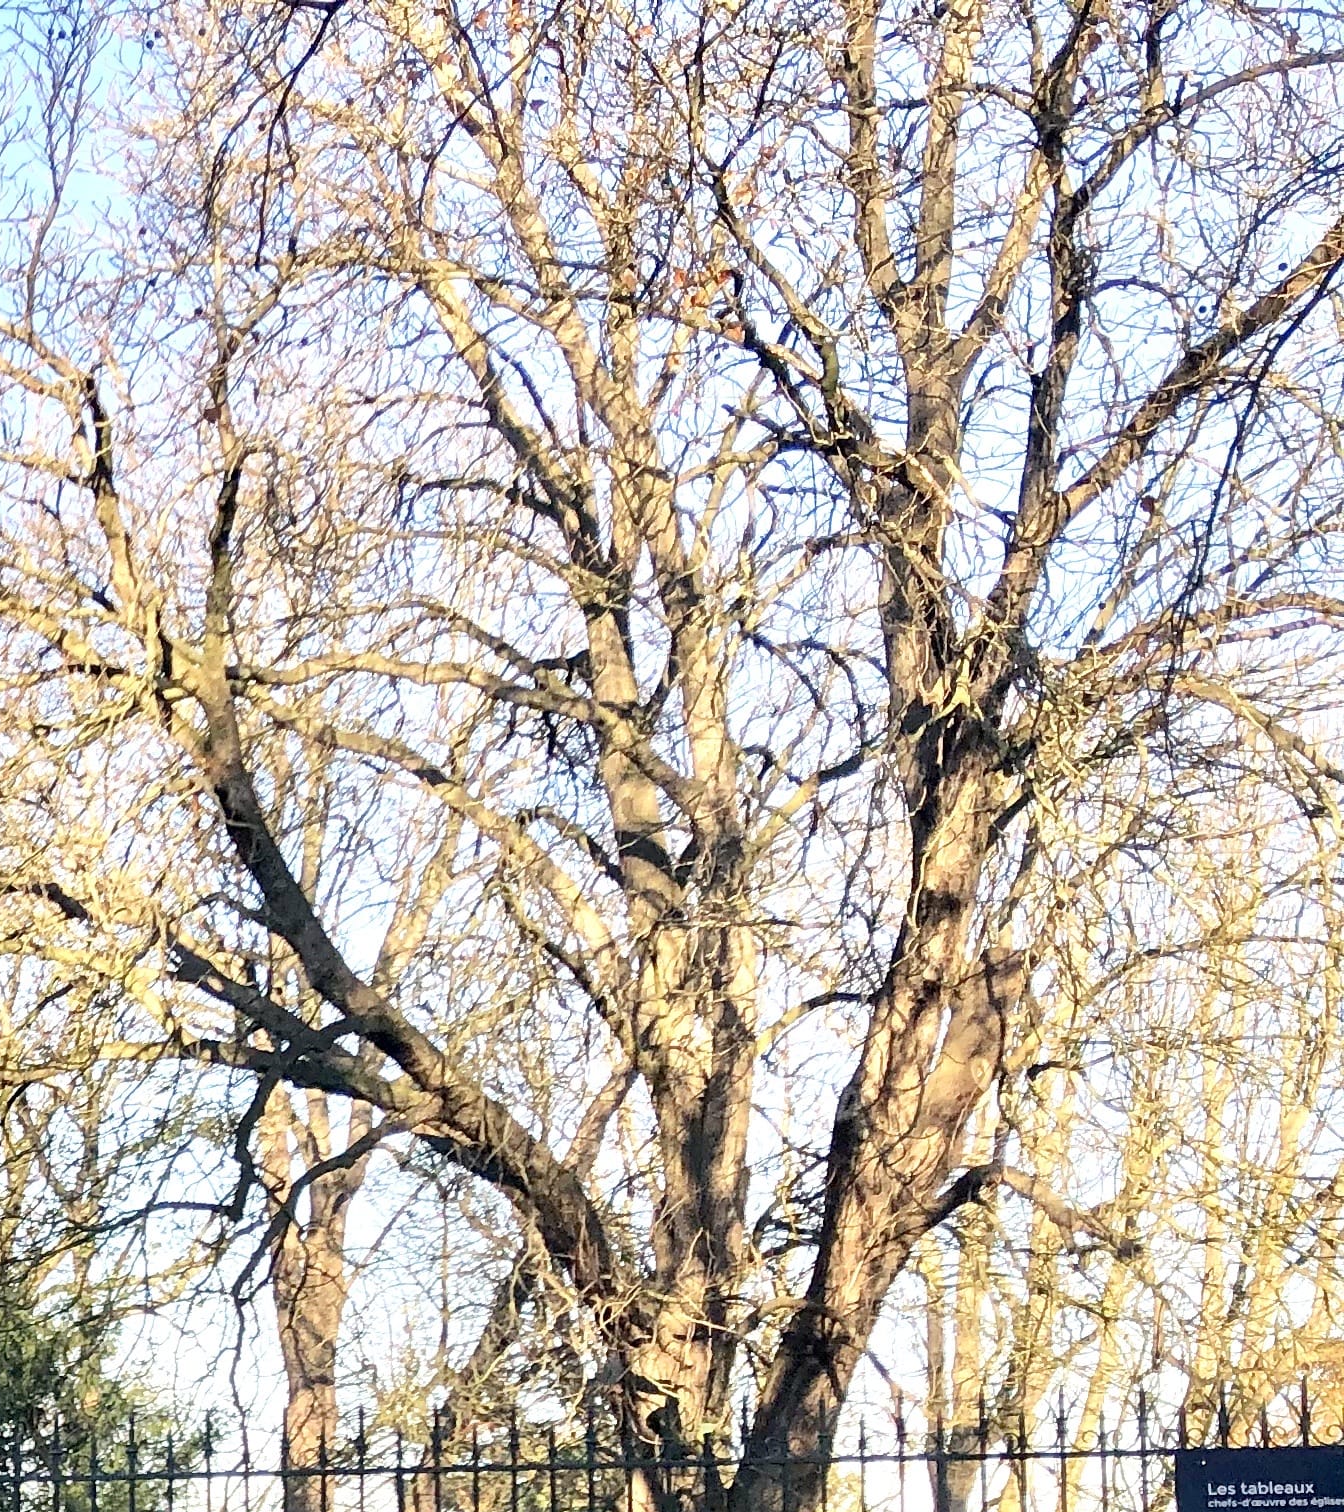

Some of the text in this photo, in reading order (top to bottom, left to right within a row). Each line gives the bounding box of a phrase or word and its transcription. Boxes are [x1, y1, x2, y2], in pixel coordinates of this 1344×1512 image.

[1207, 1481, 1315, 1496] Les tableaux
[1288, 1497, 1309, 1507] des
